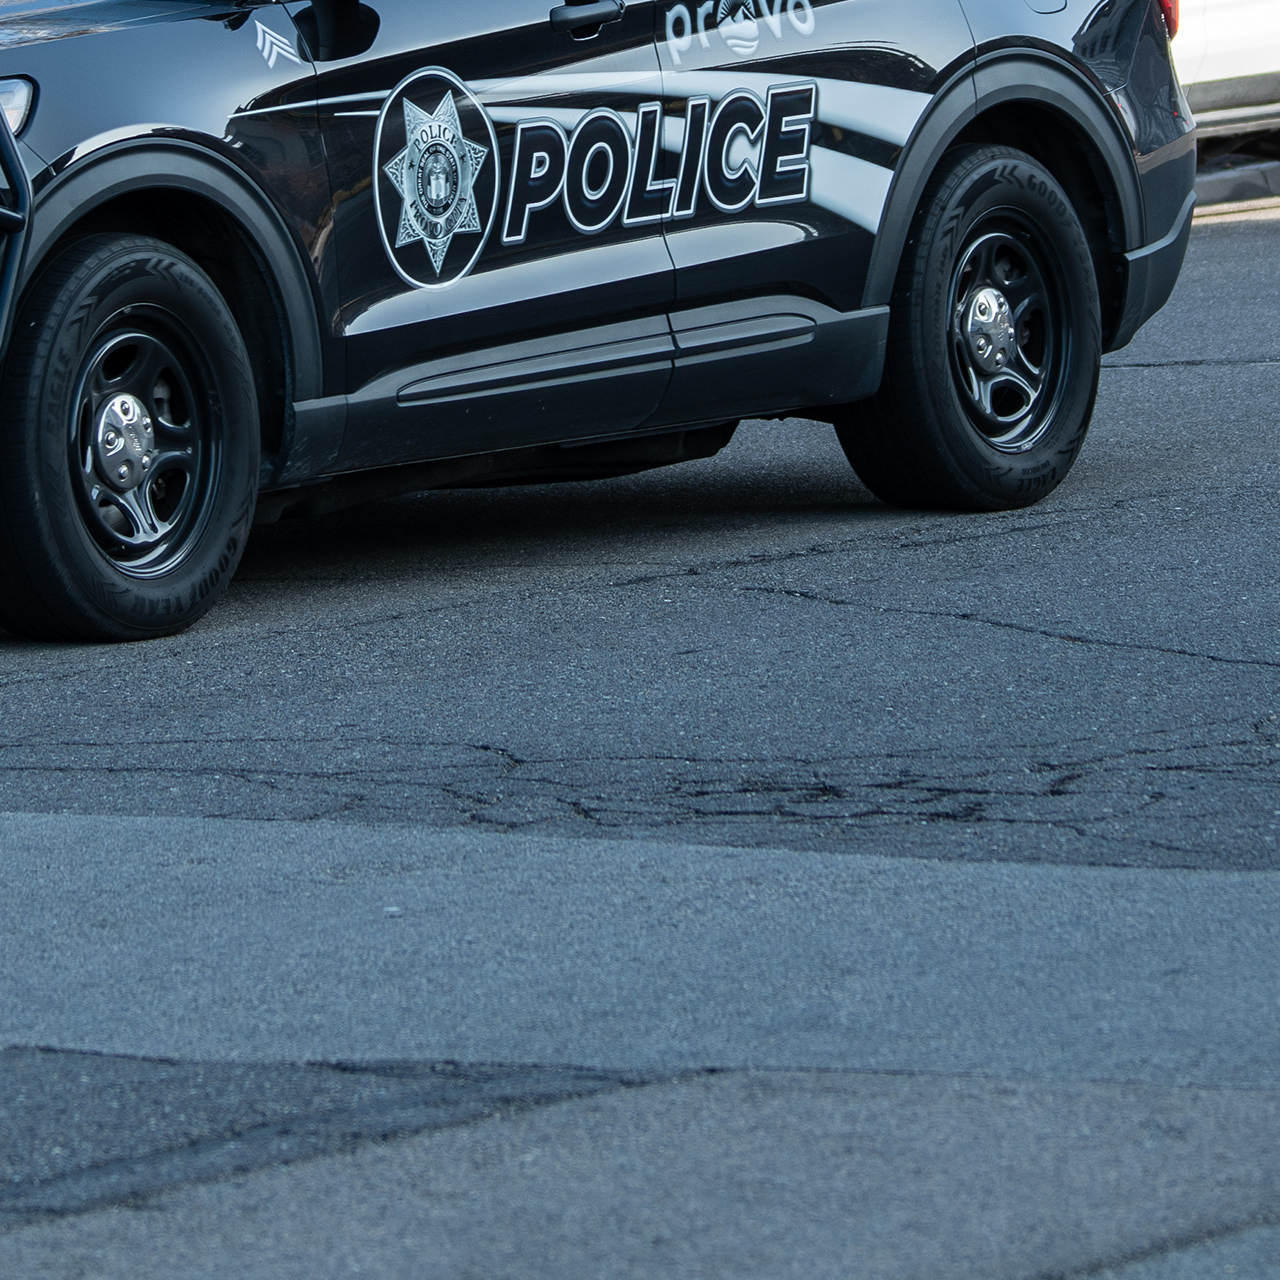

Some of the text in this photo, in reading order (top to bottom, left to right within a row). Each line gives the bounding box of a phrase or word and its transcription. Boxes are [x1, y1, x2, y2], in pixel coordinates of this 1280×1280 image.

[414, 124, 459, 152] POLICE
[501, 79, 819, 246] POLICE
[409, 199, 443, 237] PROVO
